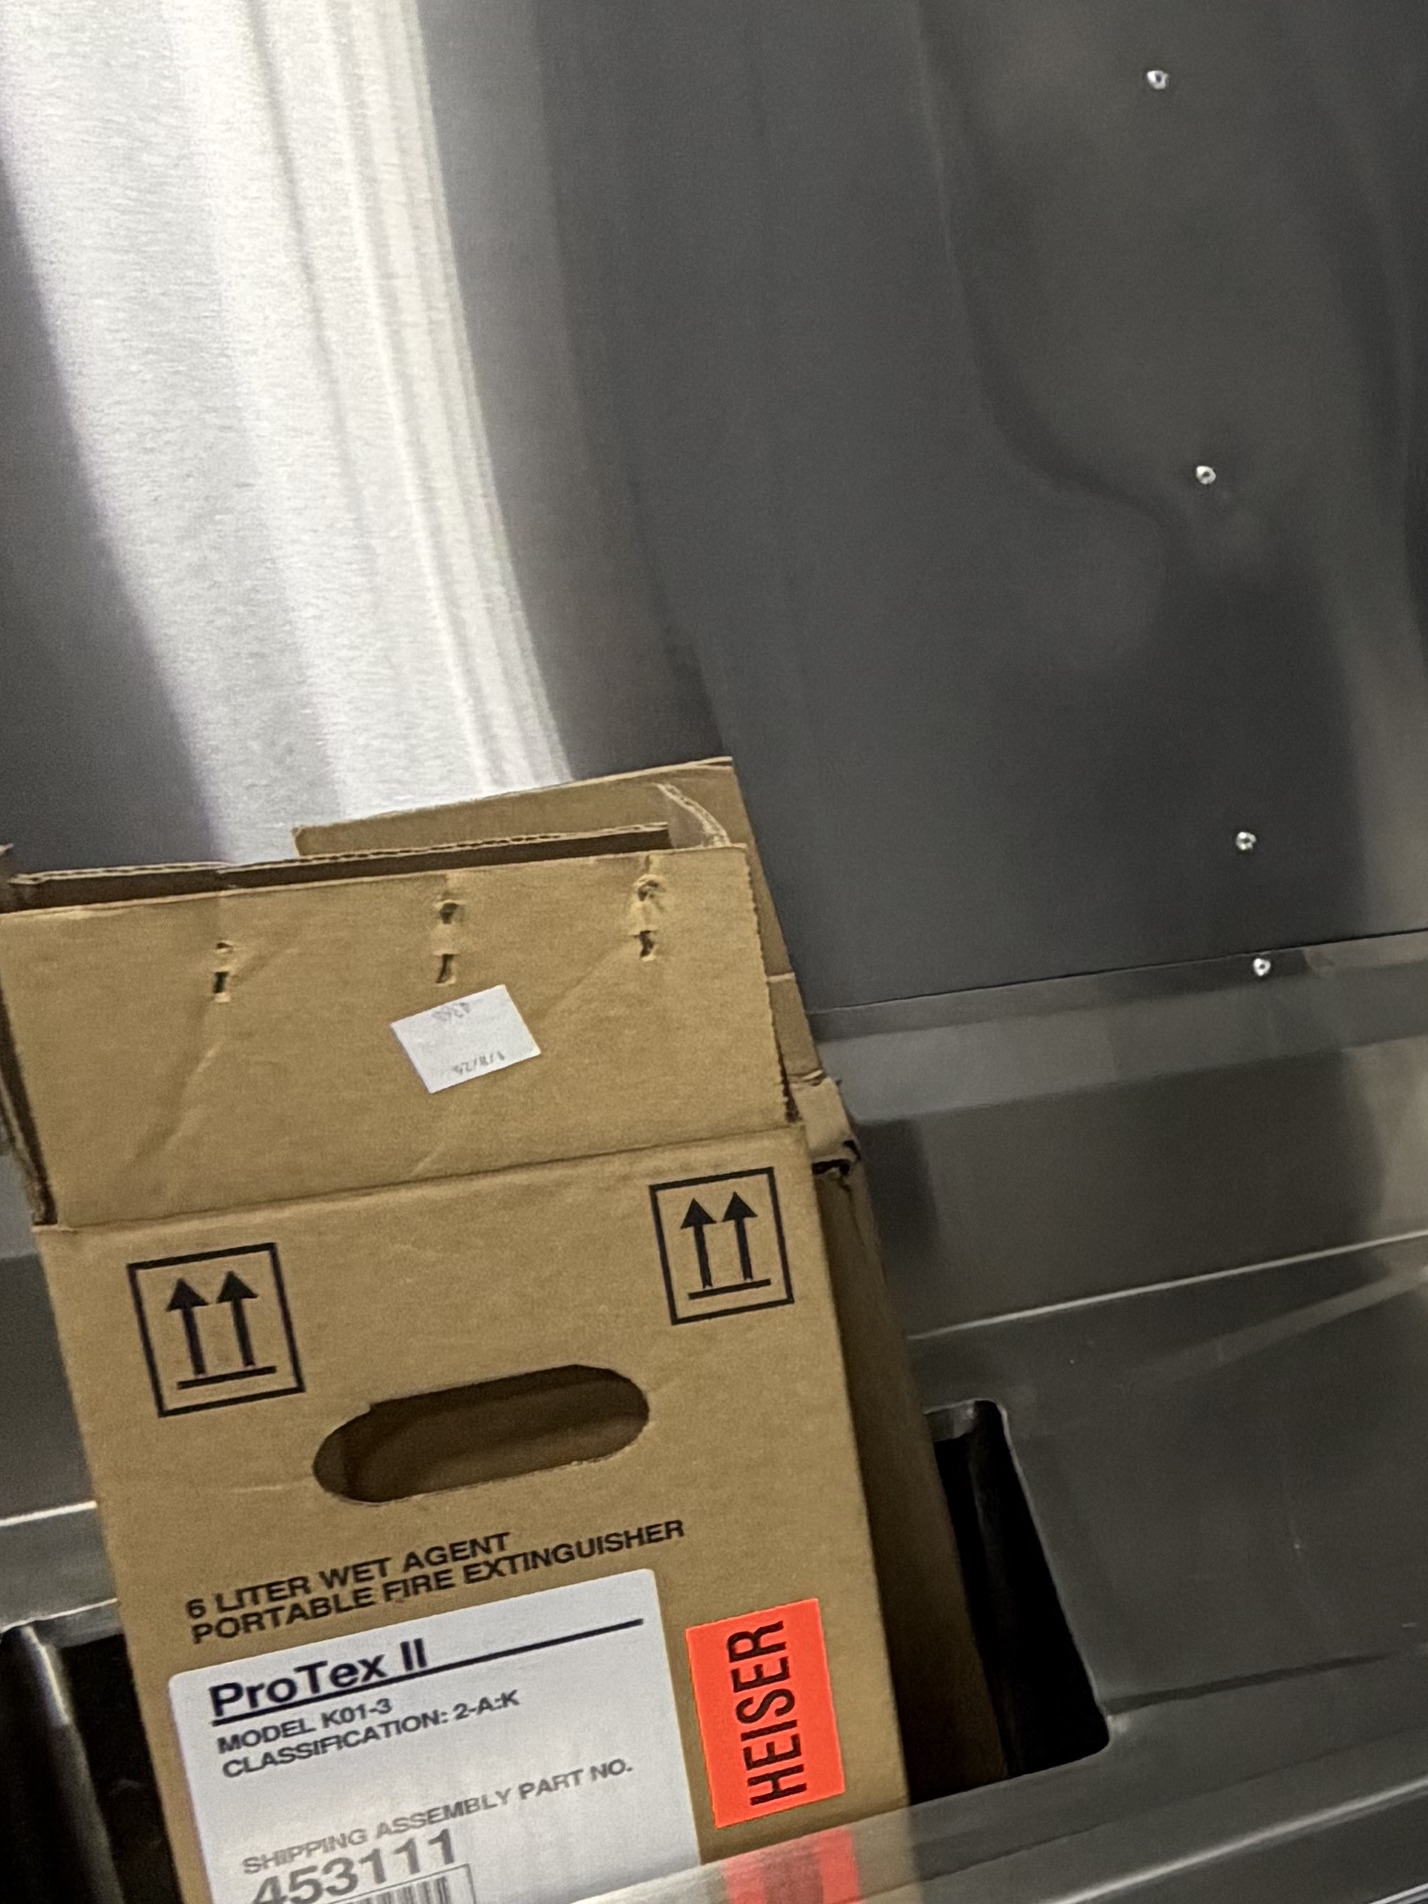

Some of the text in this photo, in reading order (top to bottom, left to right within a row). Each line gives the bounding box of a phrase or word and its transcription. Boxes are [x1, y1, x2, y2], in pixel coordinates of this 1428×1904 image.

[185, 1532, 511, 1620] 6 LITER WET AGENT
[191, 1519, 685, 1644] PORTABLE FIRE EXTINGUISHER
[209, 1638, 428, 1717] ProTex II
[726, 1620, 807, 1806] HEISER
[217, 1697, 393, 1755] MODEL K01-3
[222, 1708, 449, 1778] CLASSIFICATION:
[242, 1757, 633, 1874] SHIPPING ASSEMBLY PART NO.
